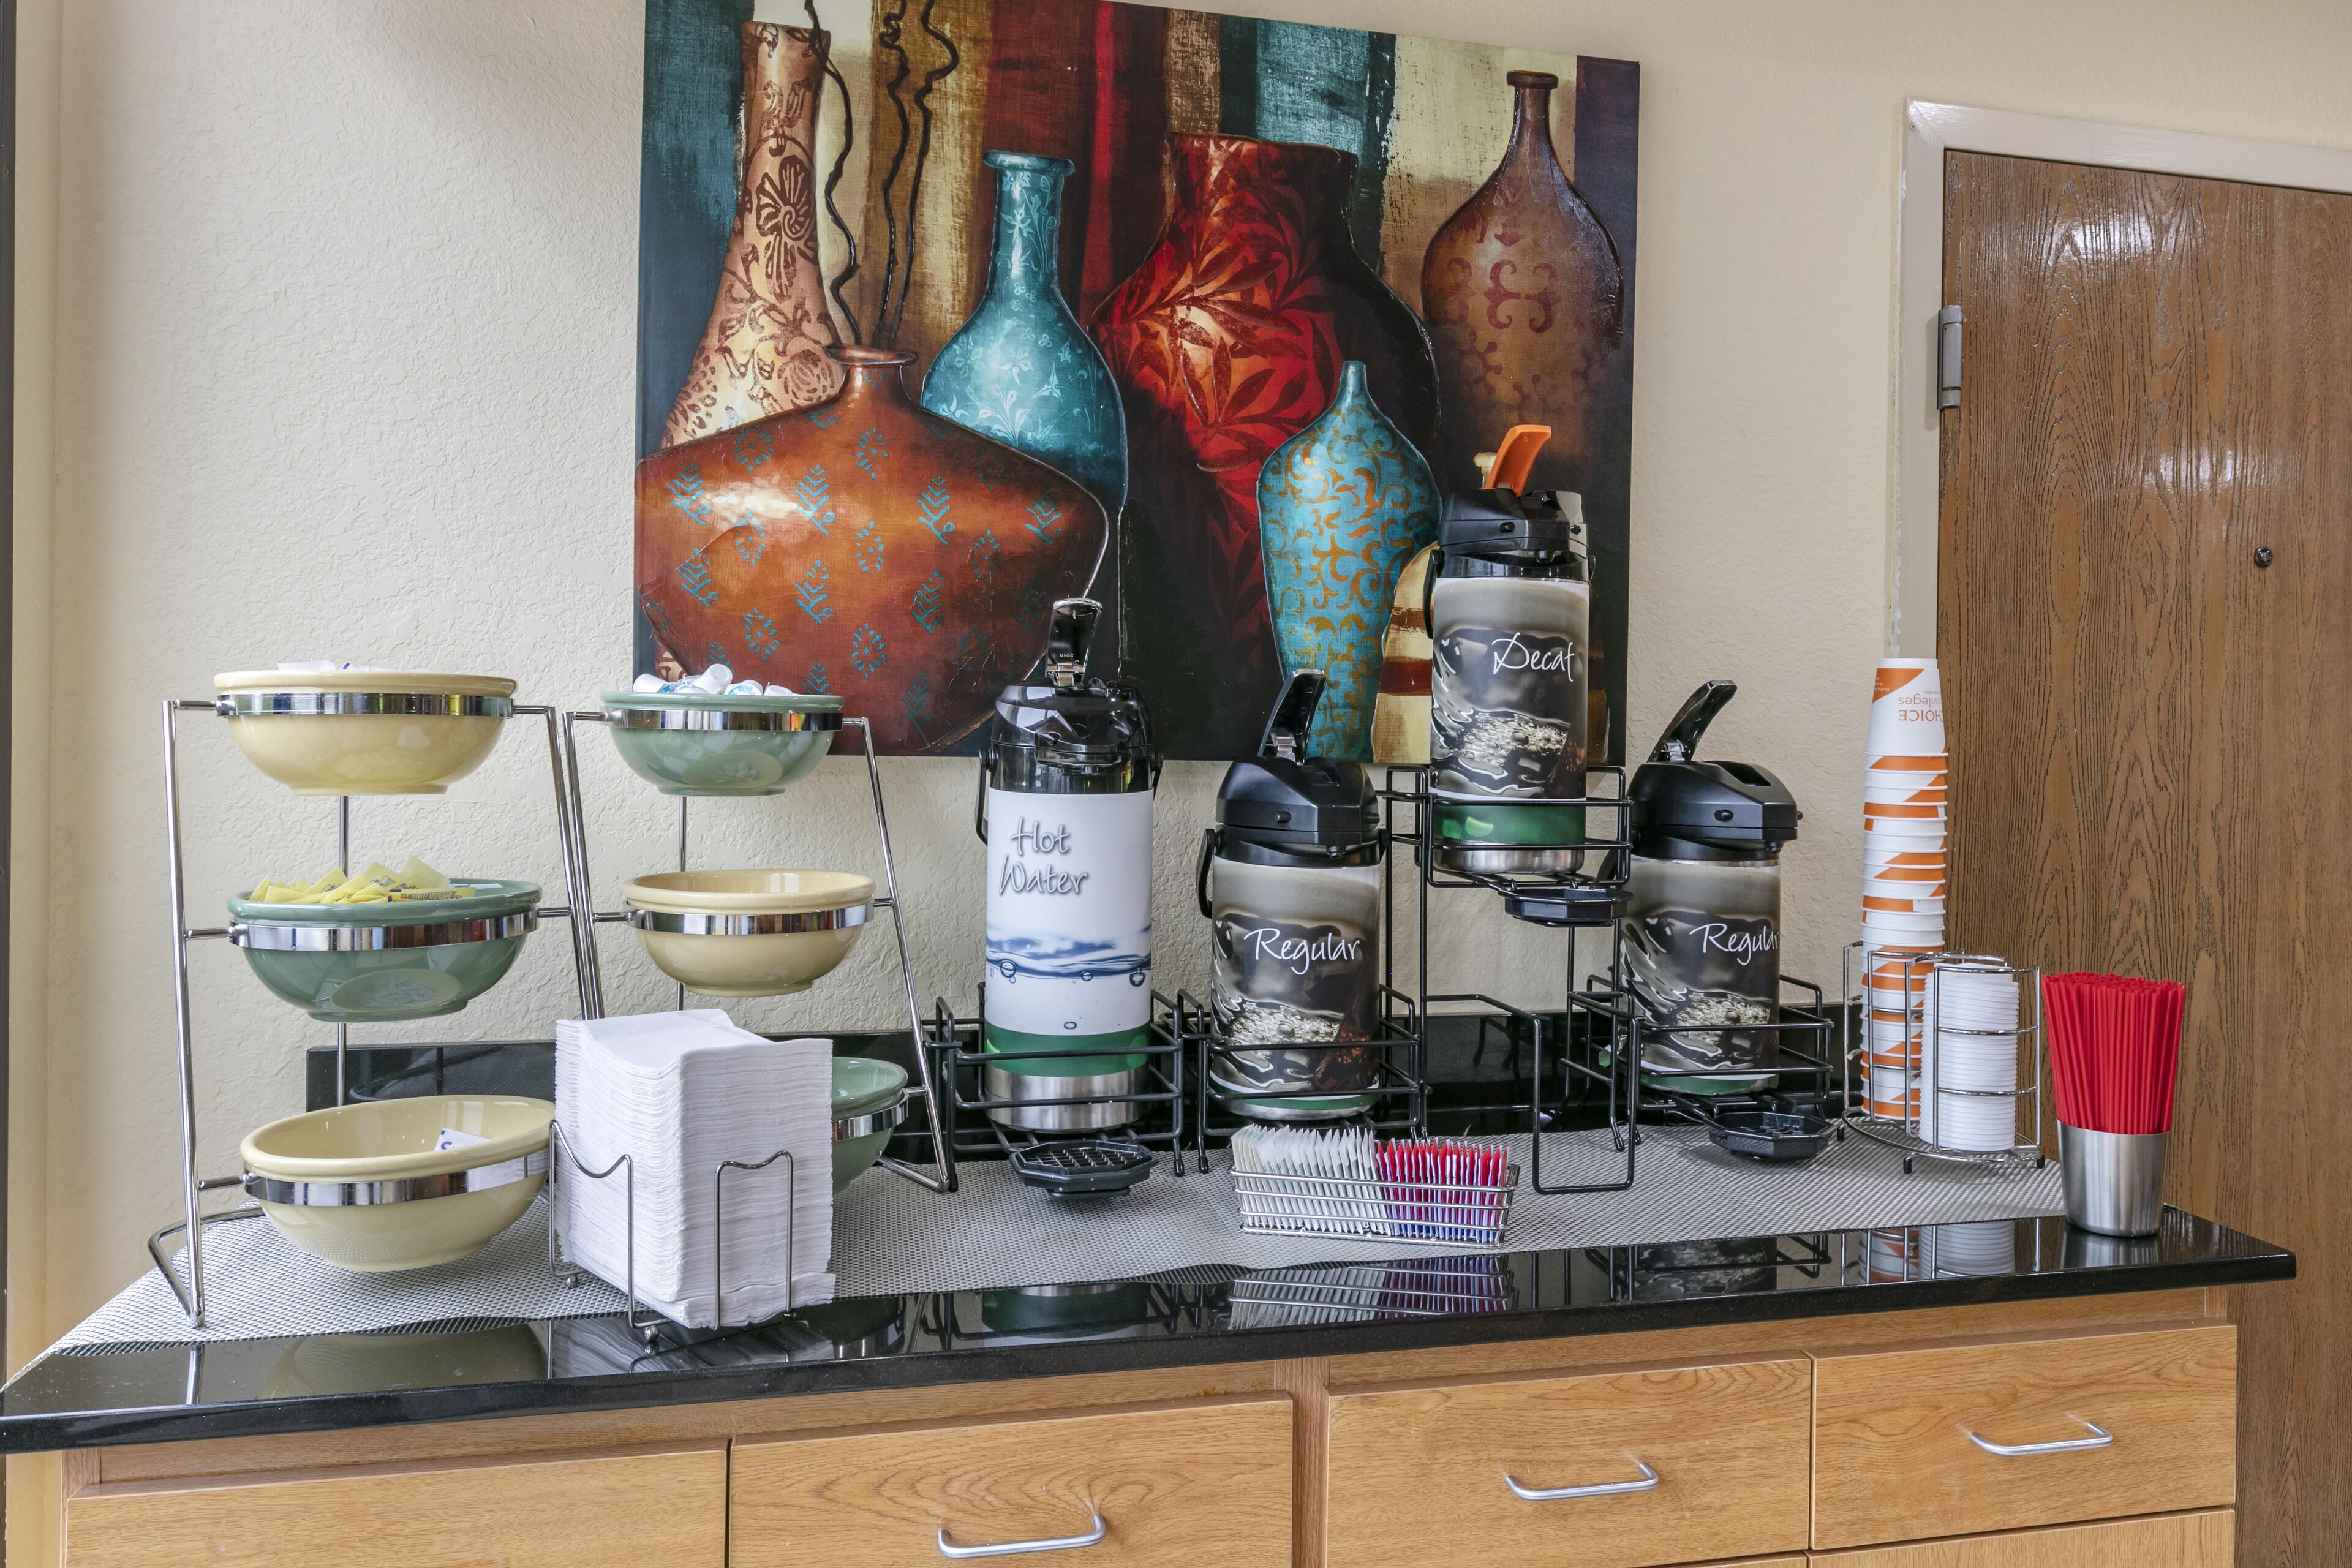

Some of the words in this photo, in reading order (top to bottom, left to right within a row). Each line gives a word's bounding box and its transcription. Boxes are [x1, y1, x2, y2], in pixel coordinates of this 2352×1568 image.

[1491, 632, 1575, 682] Decaf
[1899, 693, 1942, 709] rivileges
[1011, 816, 1070, 856] Hot
[999, 853, 1088, 895] Water
[1243, 927, 1360, 975] Regular
[1689, 922, 1779, 965] Regular
